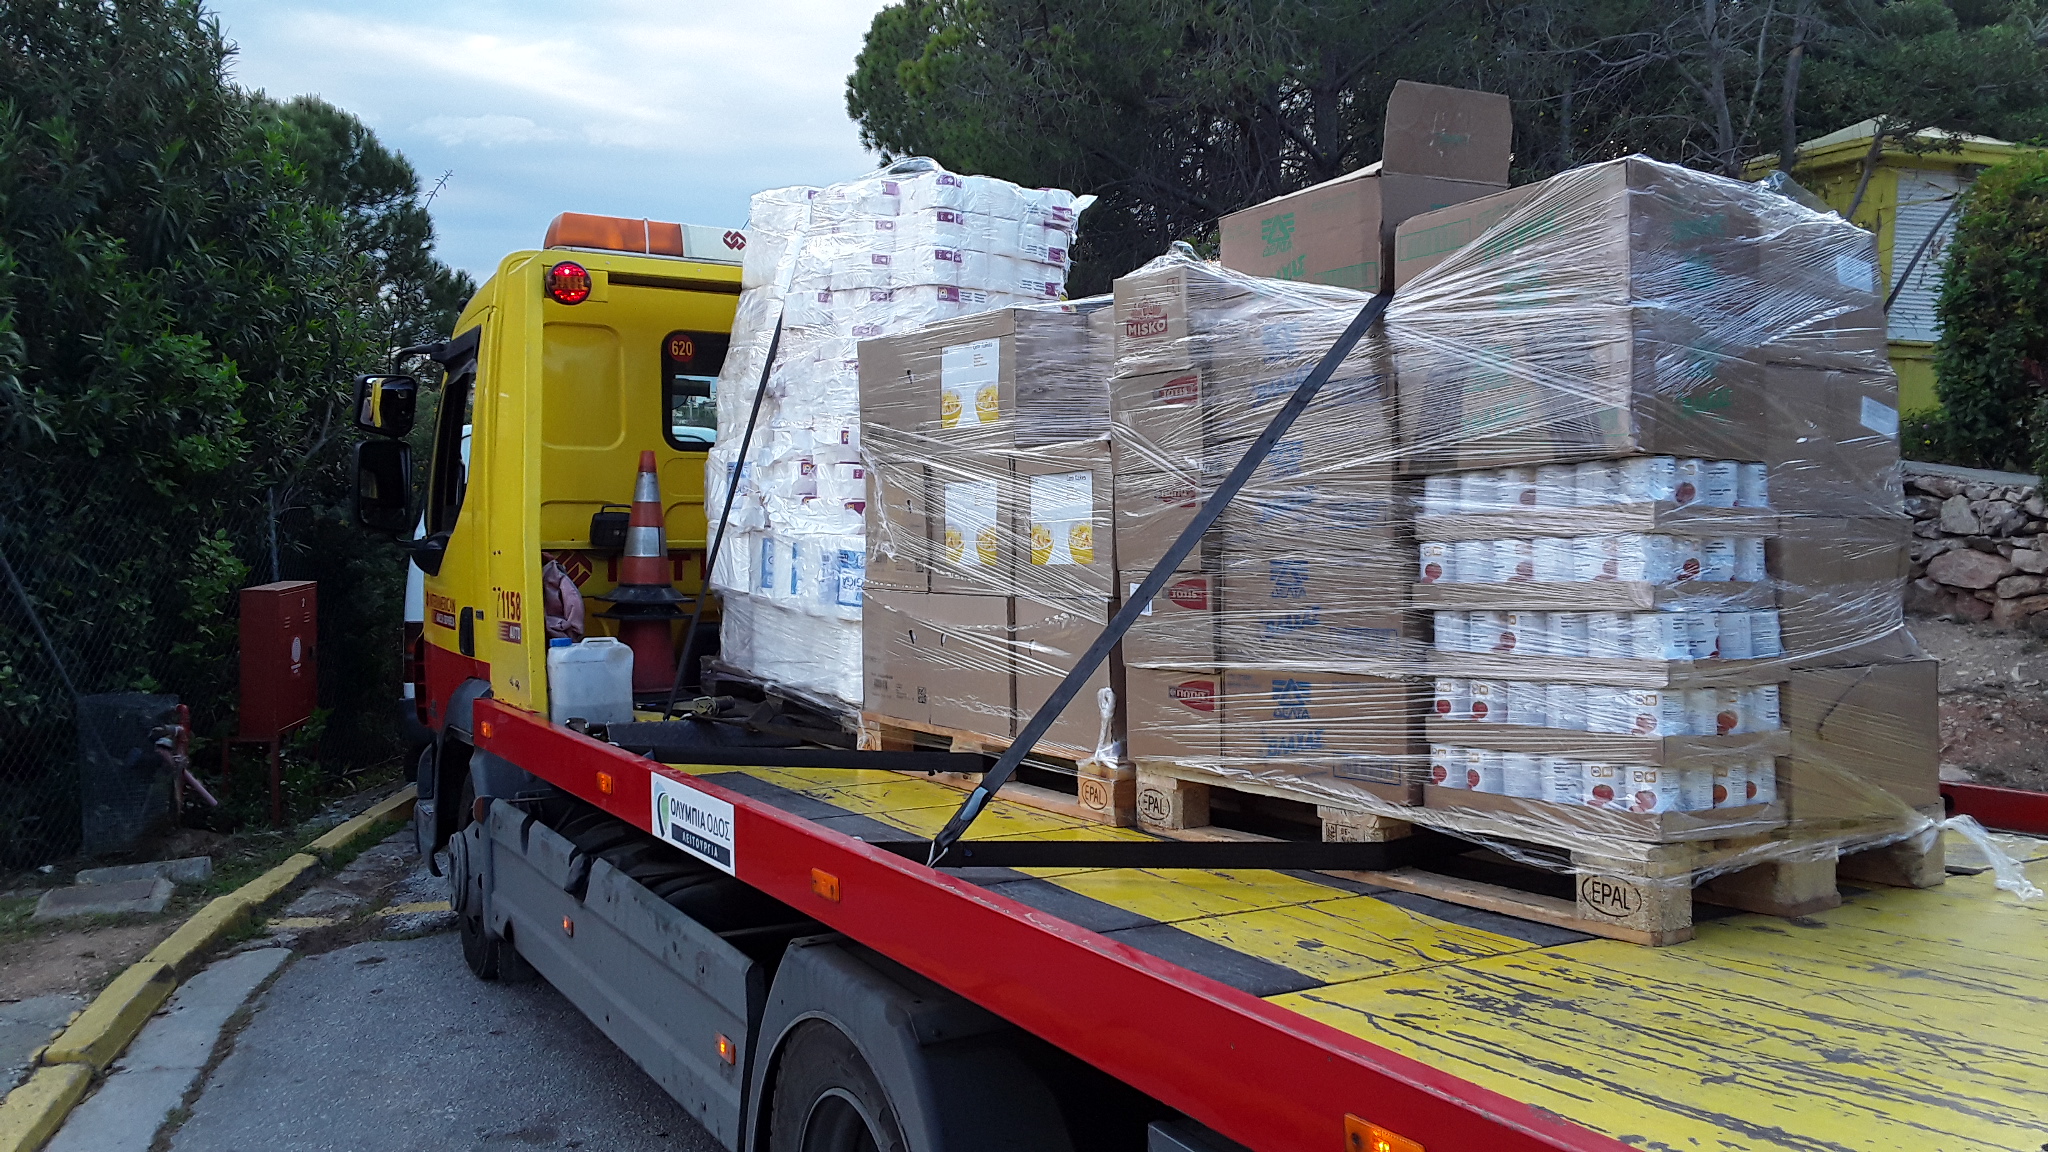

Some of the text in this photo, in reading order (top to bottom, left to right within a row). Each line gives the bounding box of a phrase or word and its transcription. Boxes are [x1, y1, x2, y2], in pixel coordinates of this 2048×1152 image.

[1128, 319, 1166, 337] MISKO
[671, 340, 693, 356] 620
[1085, 784, 1104, 805] EPAL
[1143, 793, 1165, 815] EPAL
[670, 797, 731, 841] ΟΛΥΜΠΙΑ ΟΔΟΣ
[682, 831, 718, 858] ΛΕΙΤΟΥΡΓΙΑ
[1591, 880, 1631, 910] EPAL
